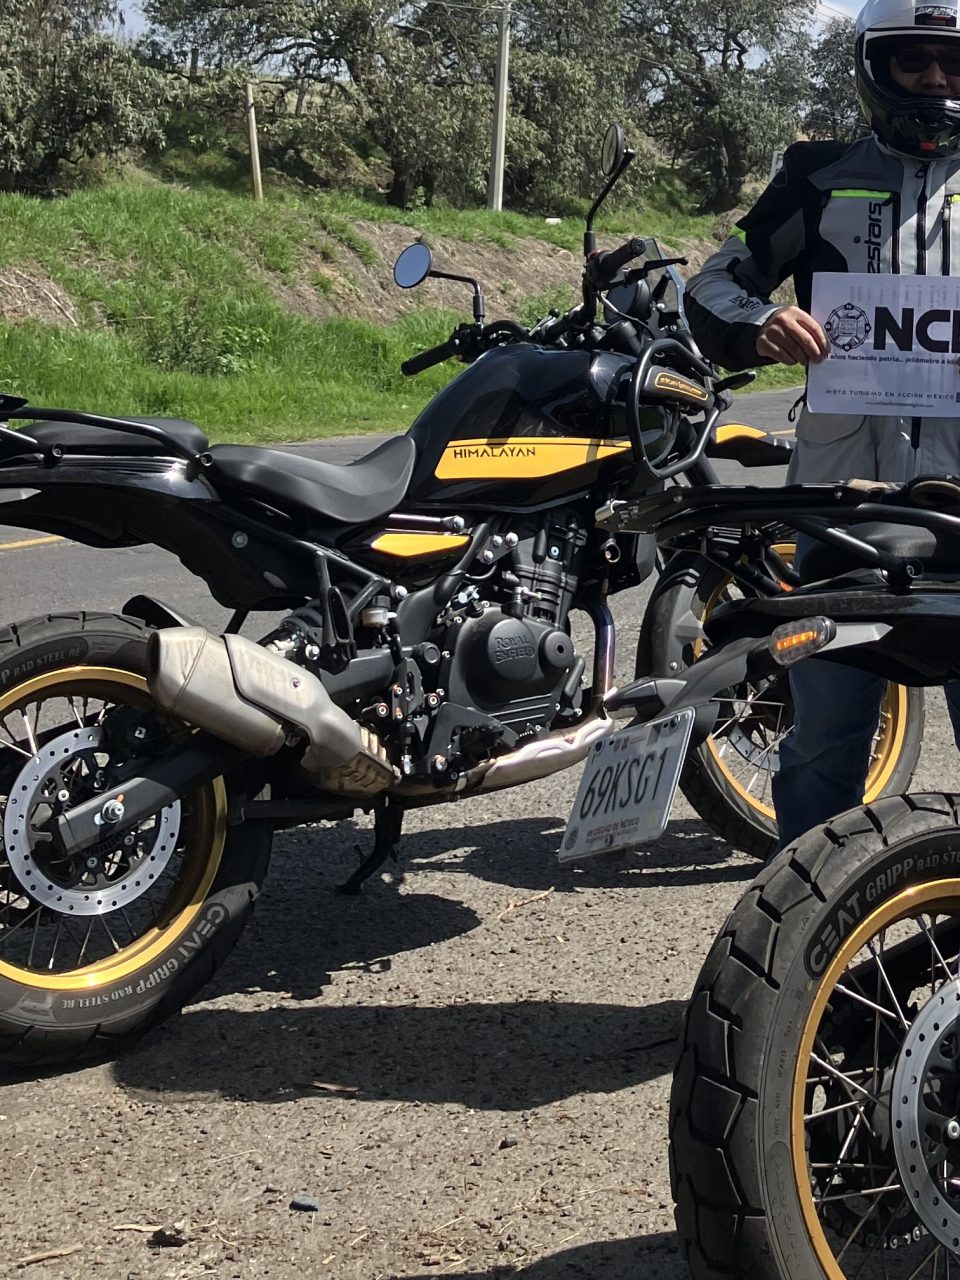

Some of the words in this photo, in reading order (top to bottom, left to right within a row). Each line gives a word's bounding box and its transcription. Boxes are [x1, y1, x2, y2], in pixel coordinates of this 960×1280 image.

[850, 389, 883, 397] TURISMO
[453, 447, 536, 459] HIMALAYAN
[579, 747, 669, 819] 69KSG1
[810, 891, 862, 974] CEAT
[865, 857, 915, 903] GRIPP
[916, 853, 940, 872] RAD
[177, 904, 226, 964] CEAT
[136, 958, 179, 995] GRIPP
[78, 994, 110, 1009] STEEL
[111, 984, 133, 1001] RAD
